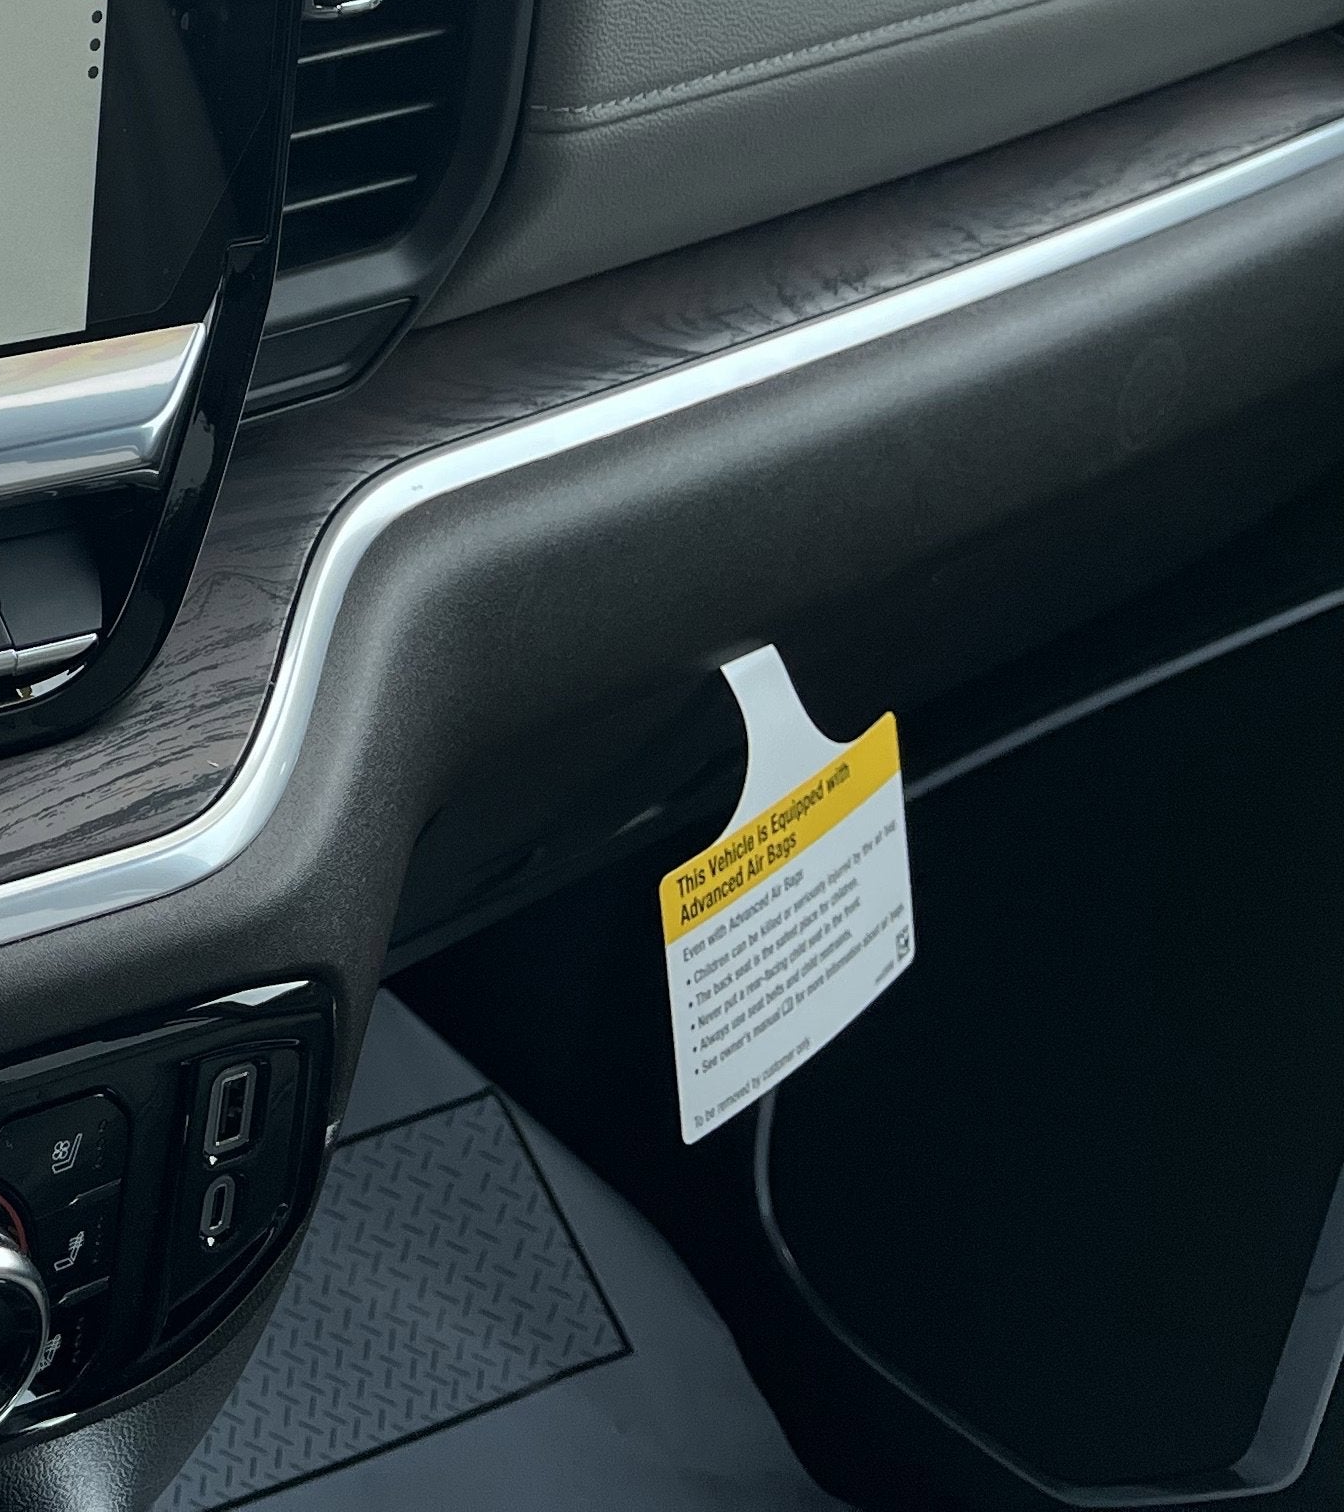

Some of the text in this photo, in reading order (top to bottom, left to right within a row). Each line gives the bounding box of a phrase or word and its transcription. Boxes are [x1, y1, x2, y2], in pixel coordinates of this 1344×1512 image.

[677, 867, 706, 898] This
[708, 833, 754, 878] Vehicle
[771, 779, 824, 835] Equipped
[826, 762, 850, 793] with
[681, 832, 797, 925] Advanced Air Bags
[683, 940, 706, 962] Even
[708, 924, 727, 946] with
[729, 892, 769, 931] Advanced
[694, 953, 730, 984] Children
[732, 941, 748, 958] can
[748, 932, 758, 946] be
[696, 989, 711, 1005] The
[714, 973, 733, 995] back
[698, 1006, 722, 1028] Never
[700, 1024, 730, 1051] Always
[702, 1055, 718, 1074] See
[753, 1008, 781, 1037] manual
[694, 1115, 704, 1128] To
